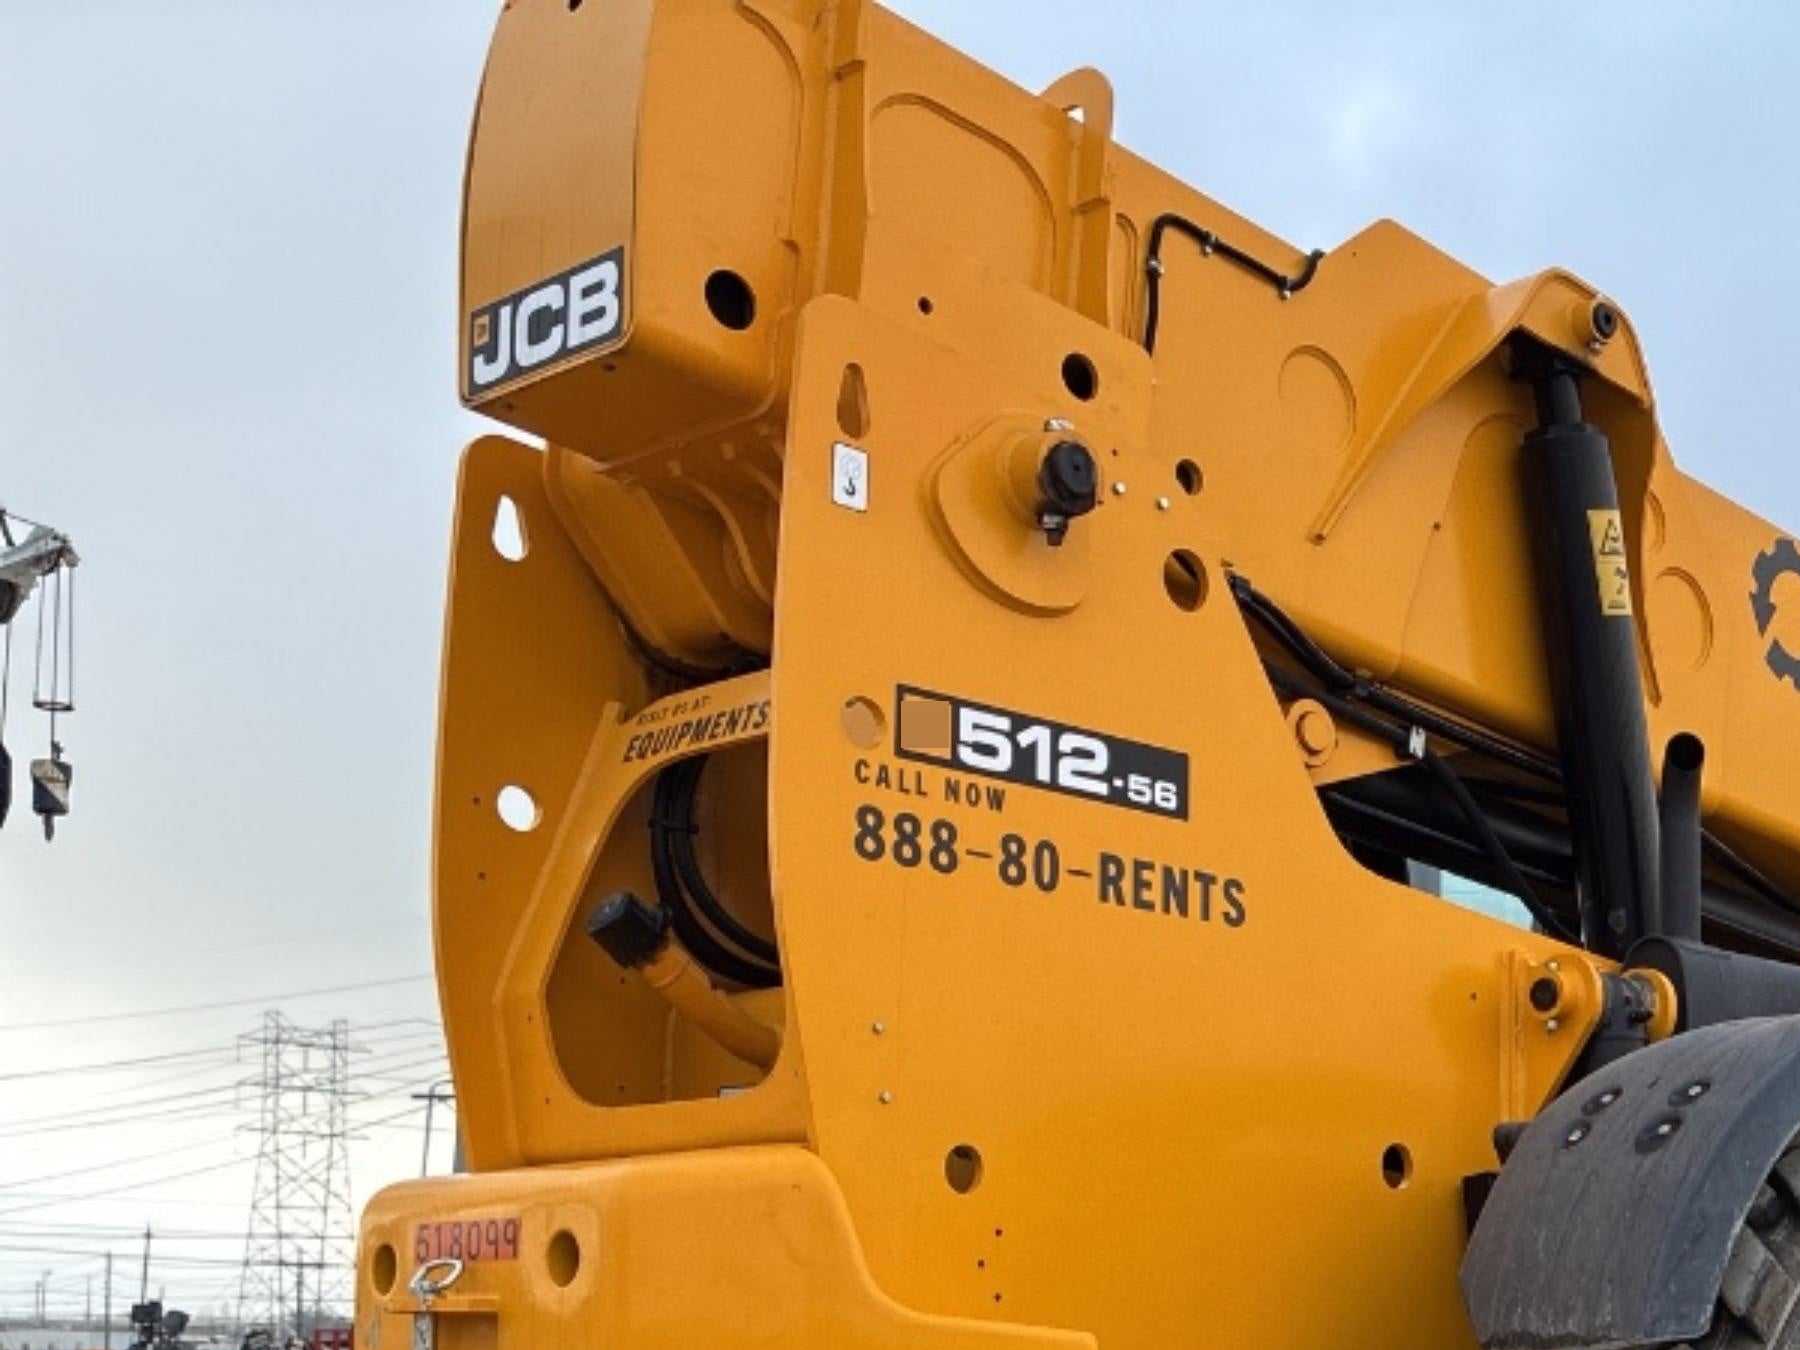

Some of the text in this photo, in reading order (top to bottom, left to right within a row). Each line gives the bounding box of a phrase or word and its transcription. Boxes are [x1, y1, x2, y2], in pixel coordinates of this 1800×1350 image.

[473, 259, 620, 386] JCB
[854, 758, 1007, 814] CALL NOW
[853, 803, 1247, 928] 888-80-RENTS
[415, 1218, 518, 1264] 518099
